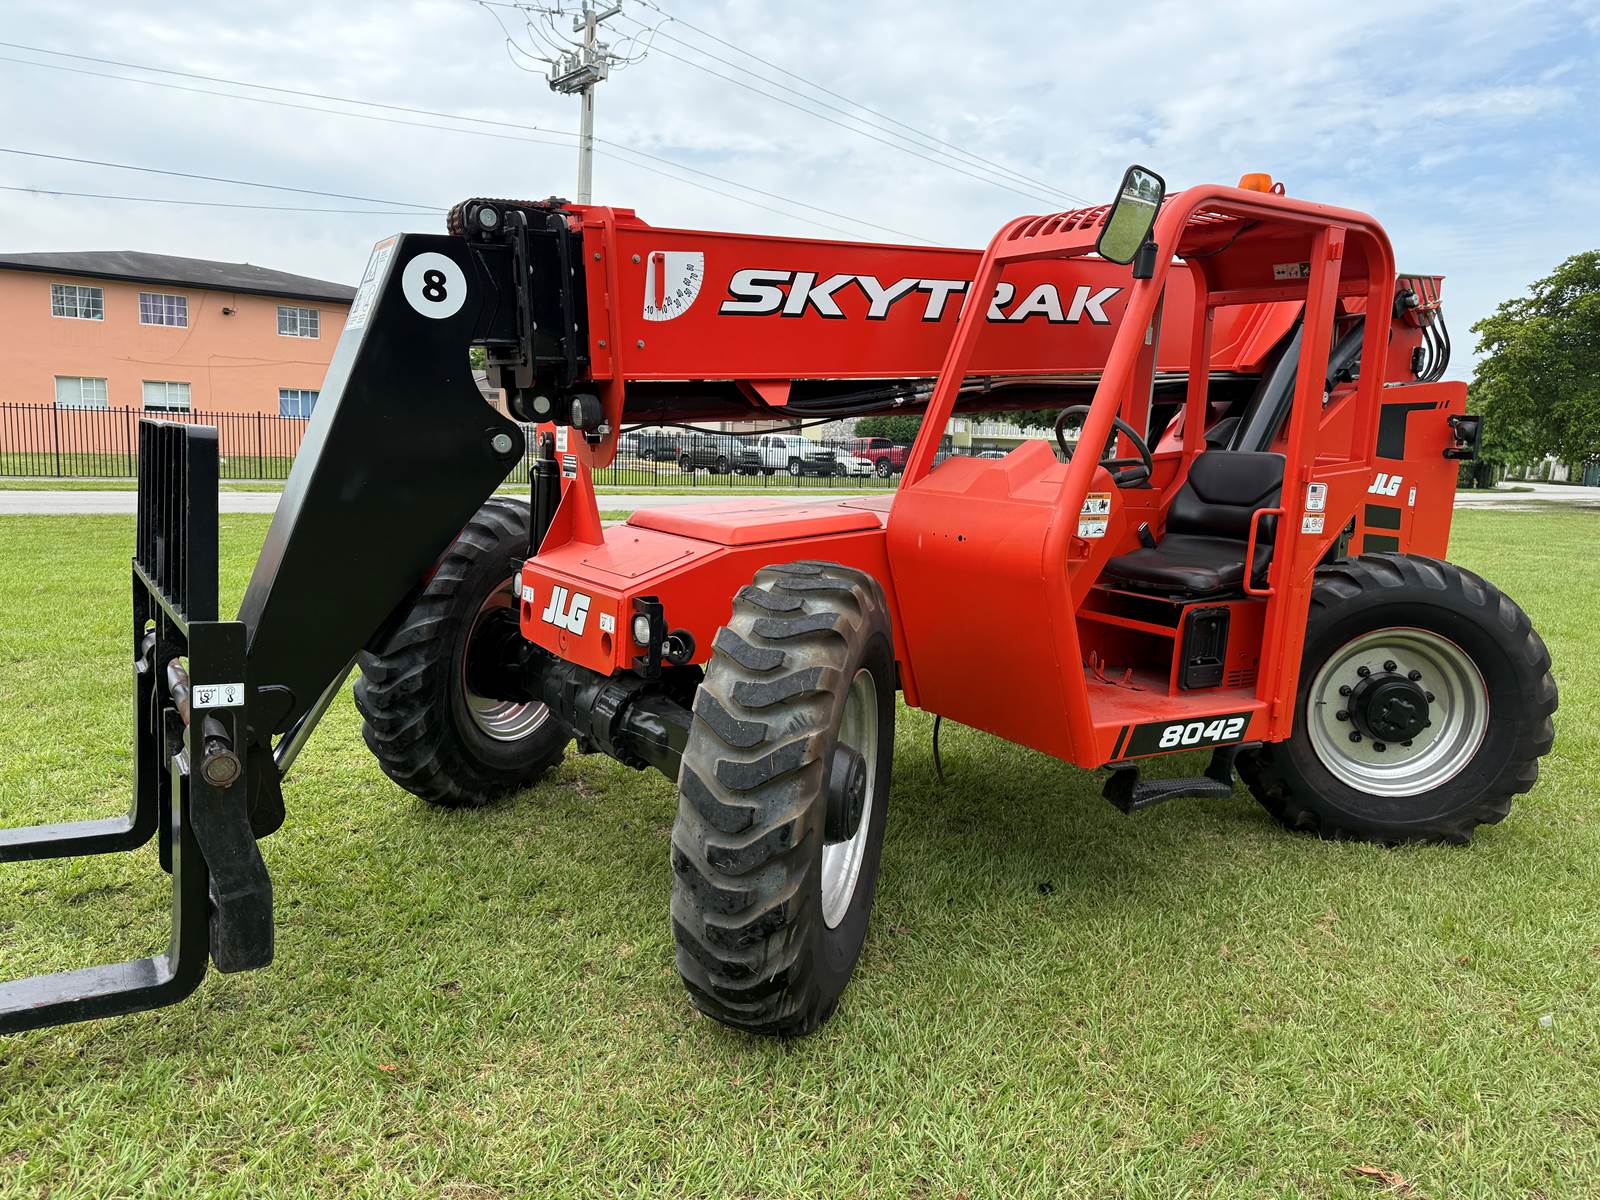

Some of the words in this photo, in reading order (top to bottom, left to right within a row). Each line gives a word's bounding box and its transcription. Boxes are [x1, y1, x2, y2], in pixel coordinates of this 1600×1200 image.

[422, 269, 448, 302] 8
[1367, 472, 1403, 497] JLG
[541, 584, 592, 637] JLG
[1159, 717, 1245, 748] 8042
